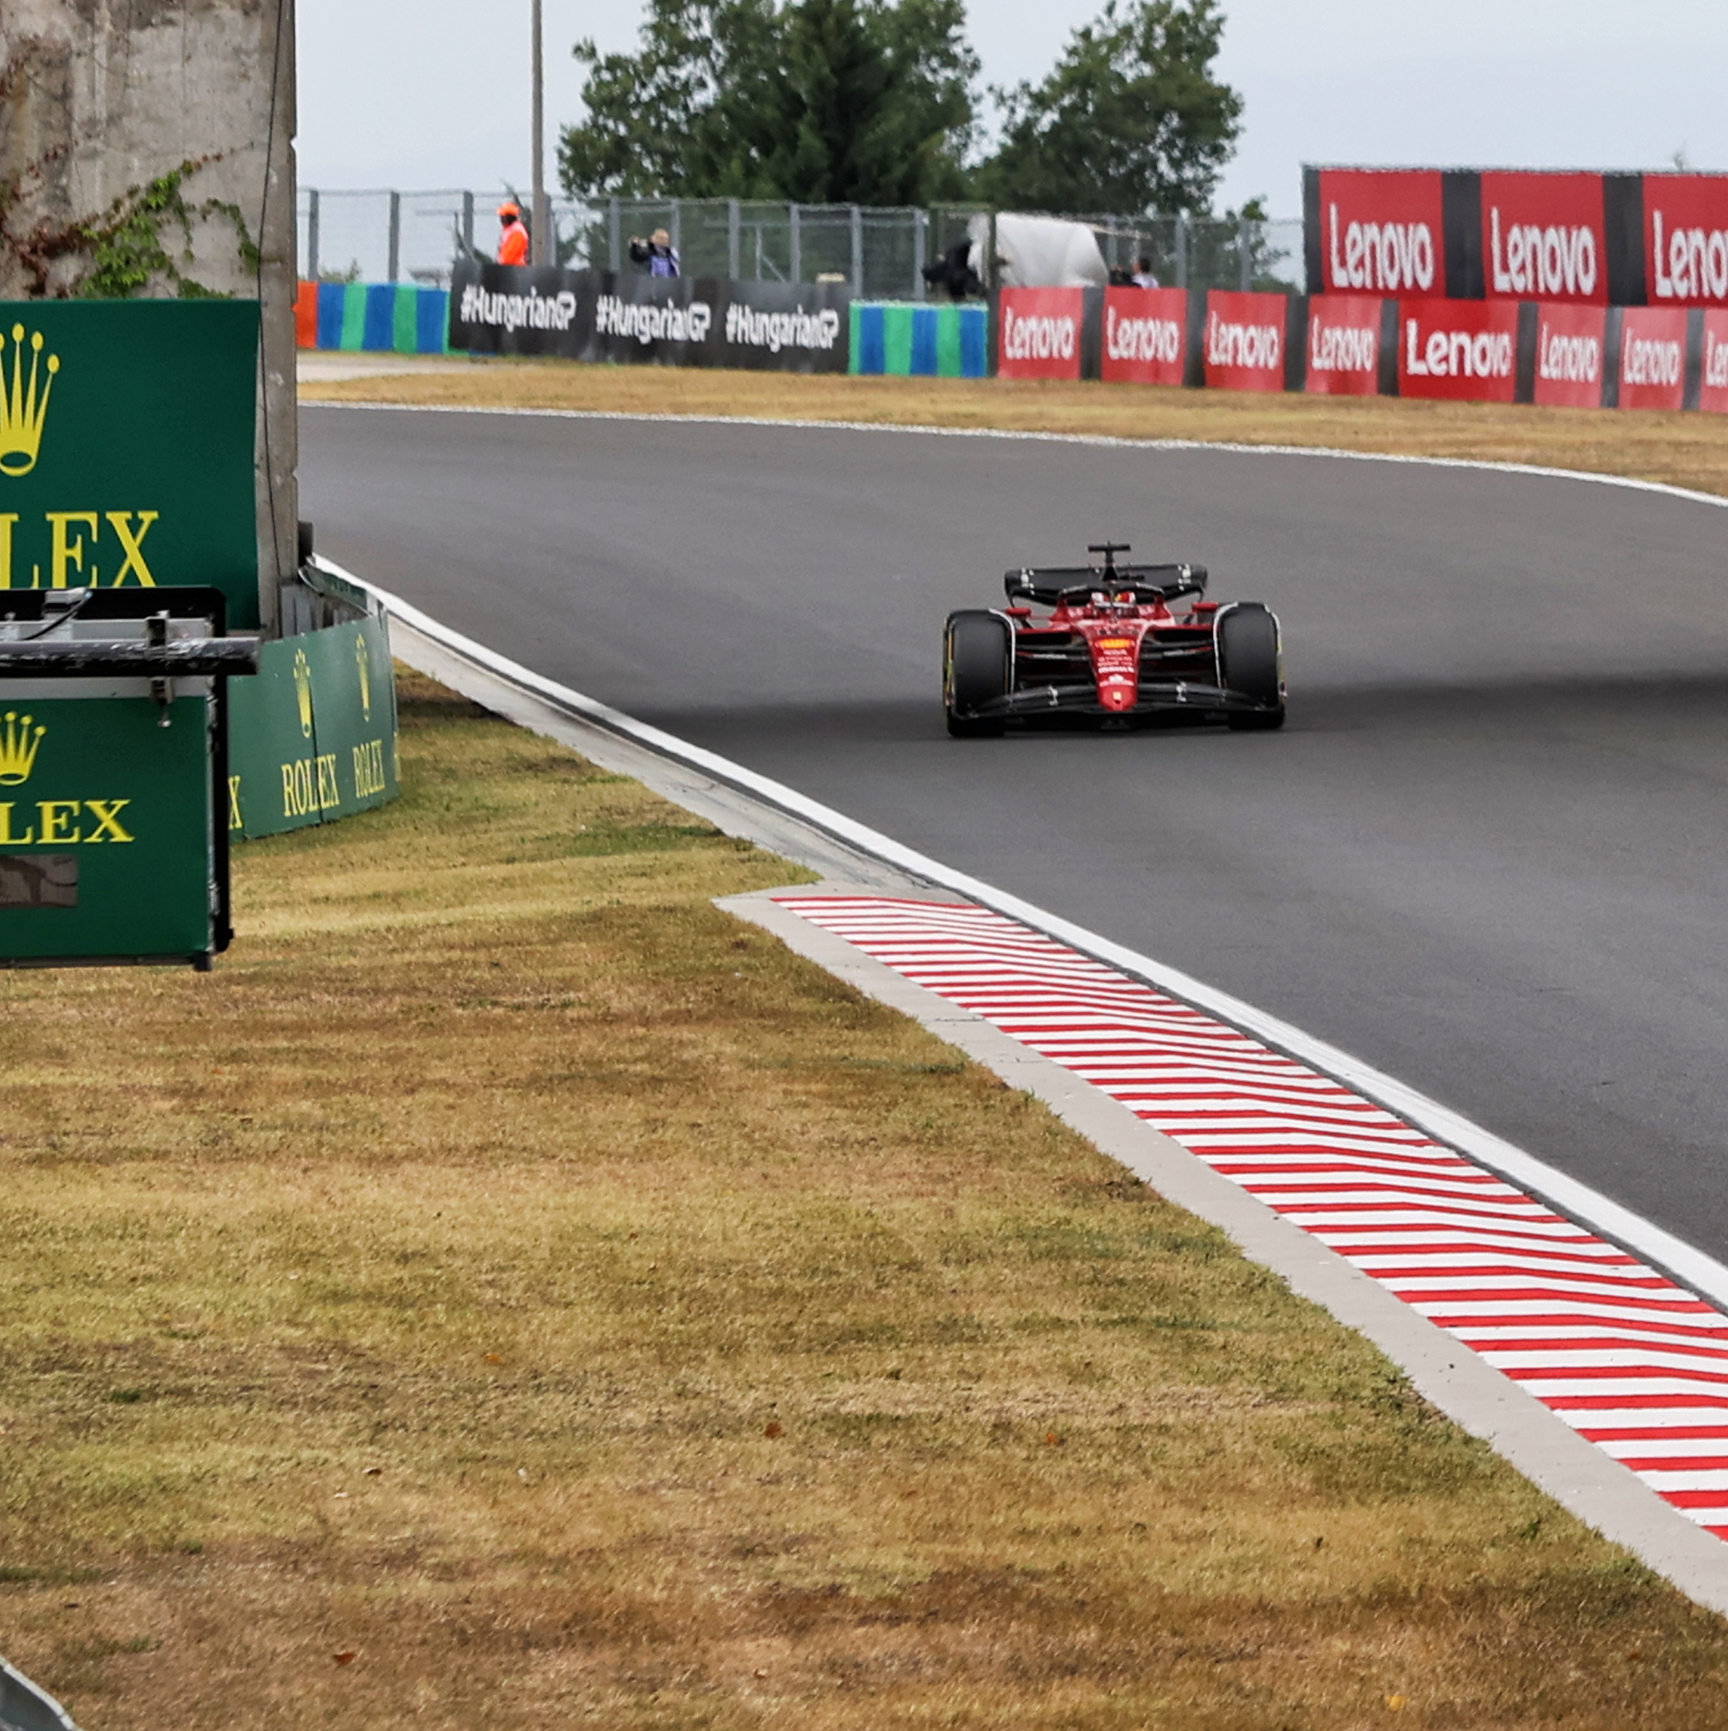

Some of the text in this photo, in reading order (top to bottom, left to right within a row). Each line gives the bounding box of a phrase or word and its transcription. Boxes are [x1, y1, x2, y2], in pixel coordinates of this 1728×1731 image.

[1330, 203, 1433, 290] Lenovo
[1491, 206, 1596, 295] Lenovo
[1005, 307, 1075, 358] Lenovo
[1107, 306, 1180, 362] Lenovo
[1209, 311, 1279, 369] Lenovo
[1312, 316, 1375, 371] Lenovo
[1407, 319, 1513, 377] Lenovo
[1540, 324, 1599, 382] Lenovo
[1624, 328, 1680, 385] Lenovo
[281, 753, 340, 817] ROLEX
[353, 739, 386, 798] ROLEX
